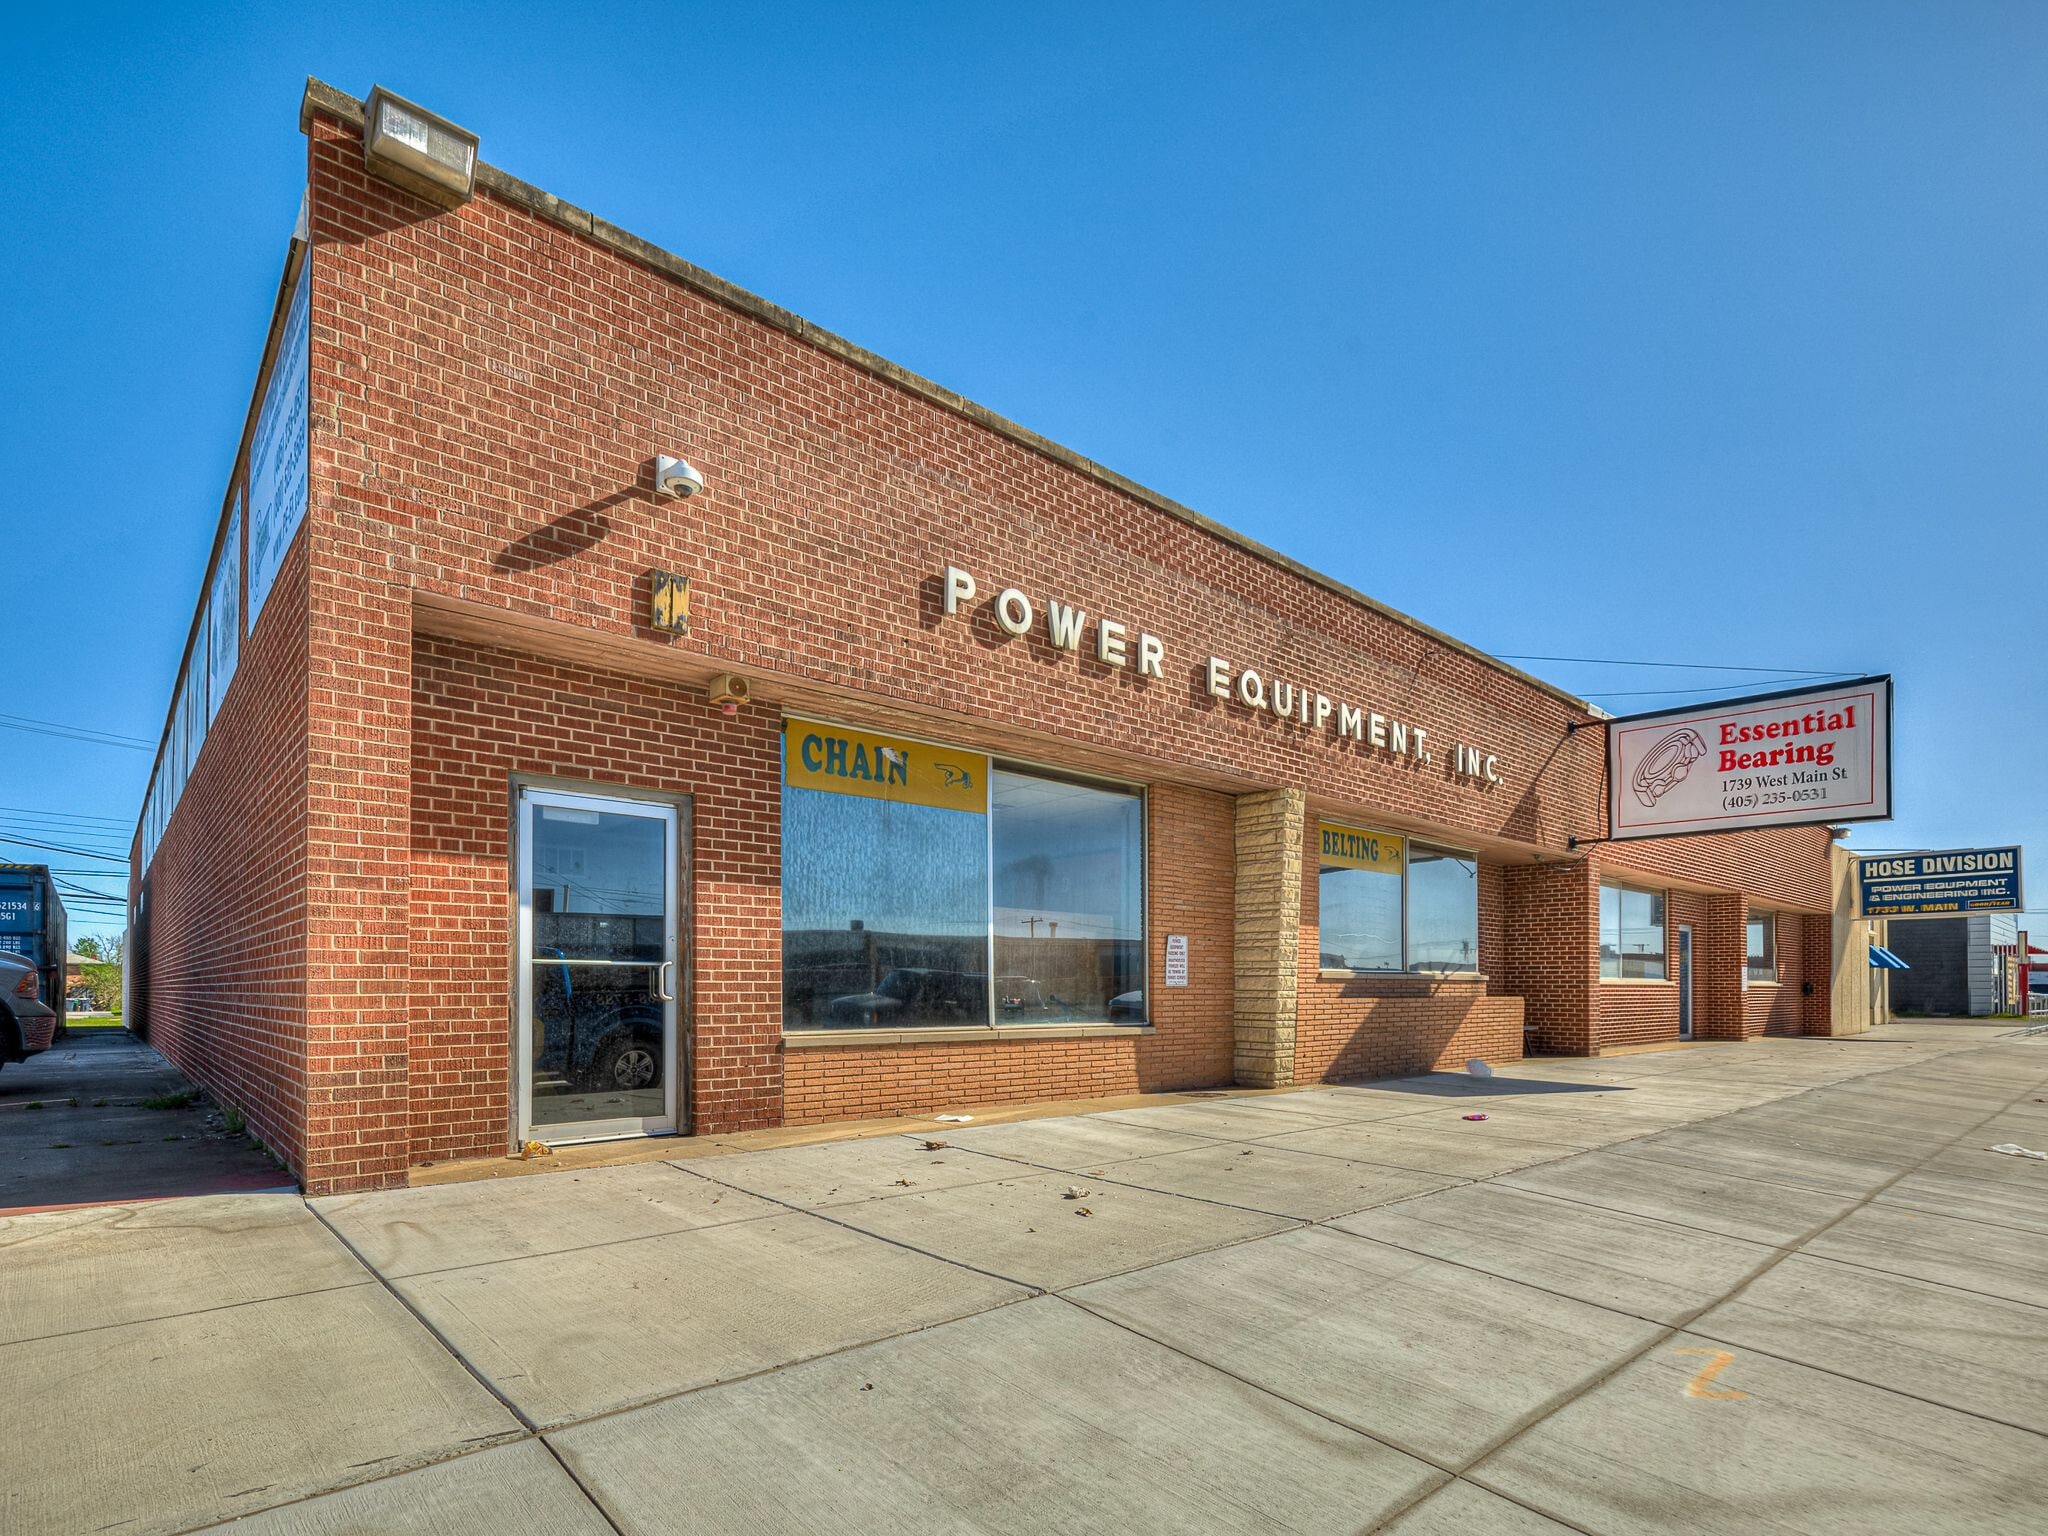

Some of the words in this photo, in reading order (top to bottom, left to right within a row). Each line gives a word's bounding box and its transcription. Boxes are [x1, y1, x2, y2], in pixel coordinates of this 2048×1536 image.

[943, 565, 1165, 679] POWER
[1206, 656, 1431, 765] EQUIPMENT,
[1456, 743, 1504, 785] INC.
[1719, 705, 1857, 746] Essential
[801, 733, 909, 786] CHAIN
[1717, 741, 1836, 773] Bearing
[1722, 777, 1753, 793] 1739
[1756, 774, 1788, 788] West
[1791, 769, 1829, 785] Main
[1831, 767, 1848, 780] St
[1722, 792, 1760, 812] (405)
[1762, 788, 1828, 805] 235-0531
[1322, 829, 1379, 862] BELTING
[1865, 859, 1915, 877] HOSE
[1922, 852, 2014, 873] DIVISION
[1871, 883, 1921, 893] POWER
[1923, 878, 2008, 890] EQUIPMENT
[1883, 889, 1979, 901] ENGINEERING
[1981, 887, 2011, 896] INC.
[0, 902, 27, 911] 21534
[0, 912, 16, 920] 5G1
[1921, 903, 1959, 912] MAIN
